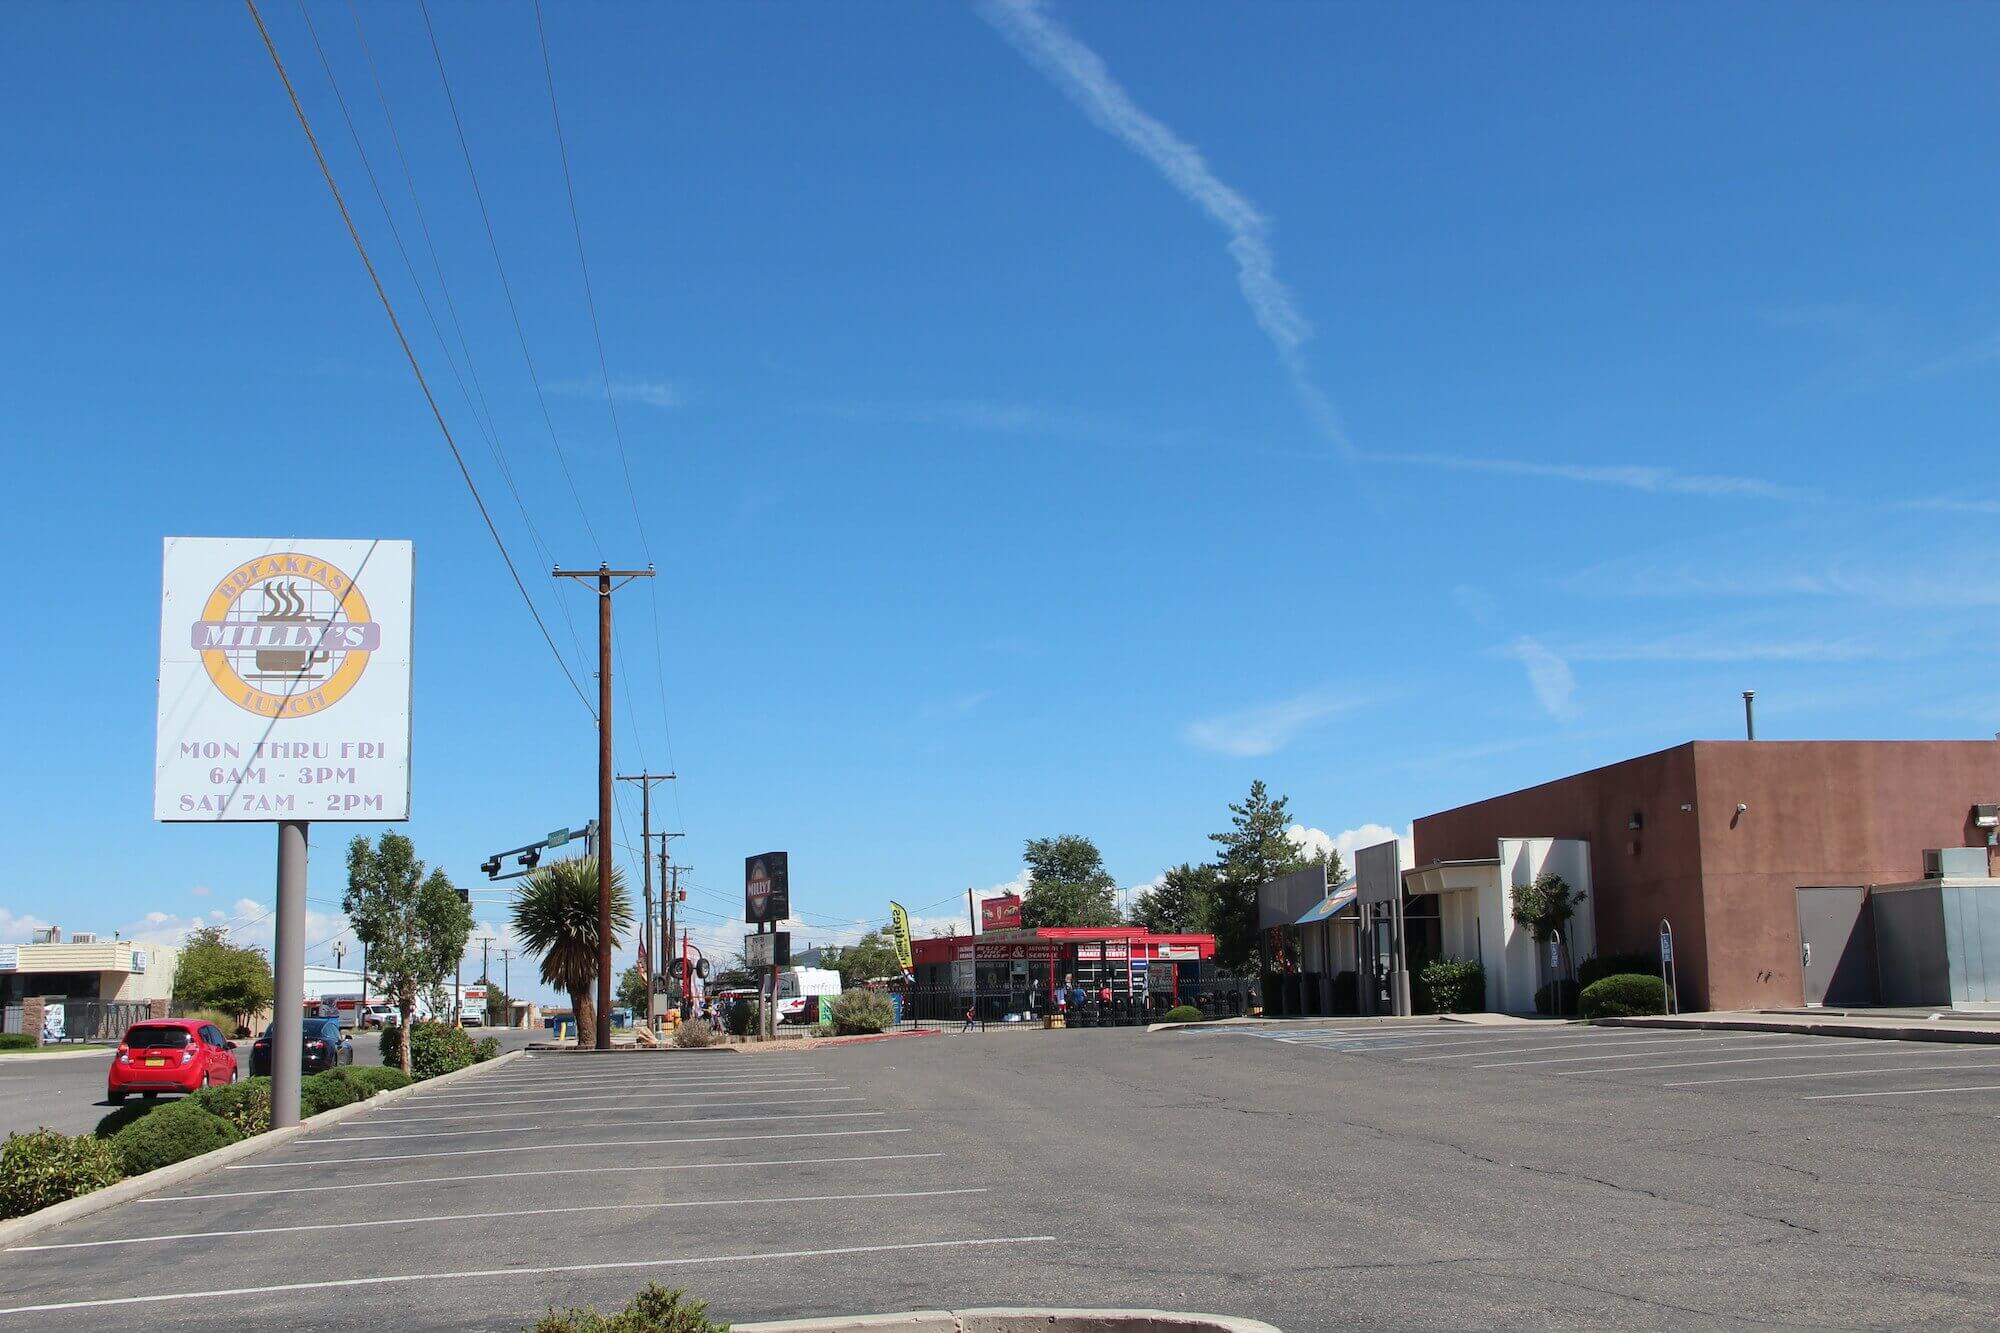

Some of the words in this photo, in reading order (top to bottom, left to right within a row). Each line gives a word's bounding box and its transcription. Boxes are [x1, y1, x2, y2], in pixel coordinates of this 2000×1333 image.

[219, 555, 356, 600] BREAKFAST
[202, 625, 365, 648] MILLY'S
[243, 691, 326, 713] LUNCH
[180, 742, 241, 758] MON
[254, 742, 329, 758] THRU
[341, 742, 385, 758] FRI
[209, 767, 267, 784] 6AM
[299, 767, 356, 784] 3PM
[180, 795, 229, 811] SAT
[243, 795, 295, 811] 7AM
[327, 794, 383, 811] 2PM
[1012, 945, 1024, 959] &
